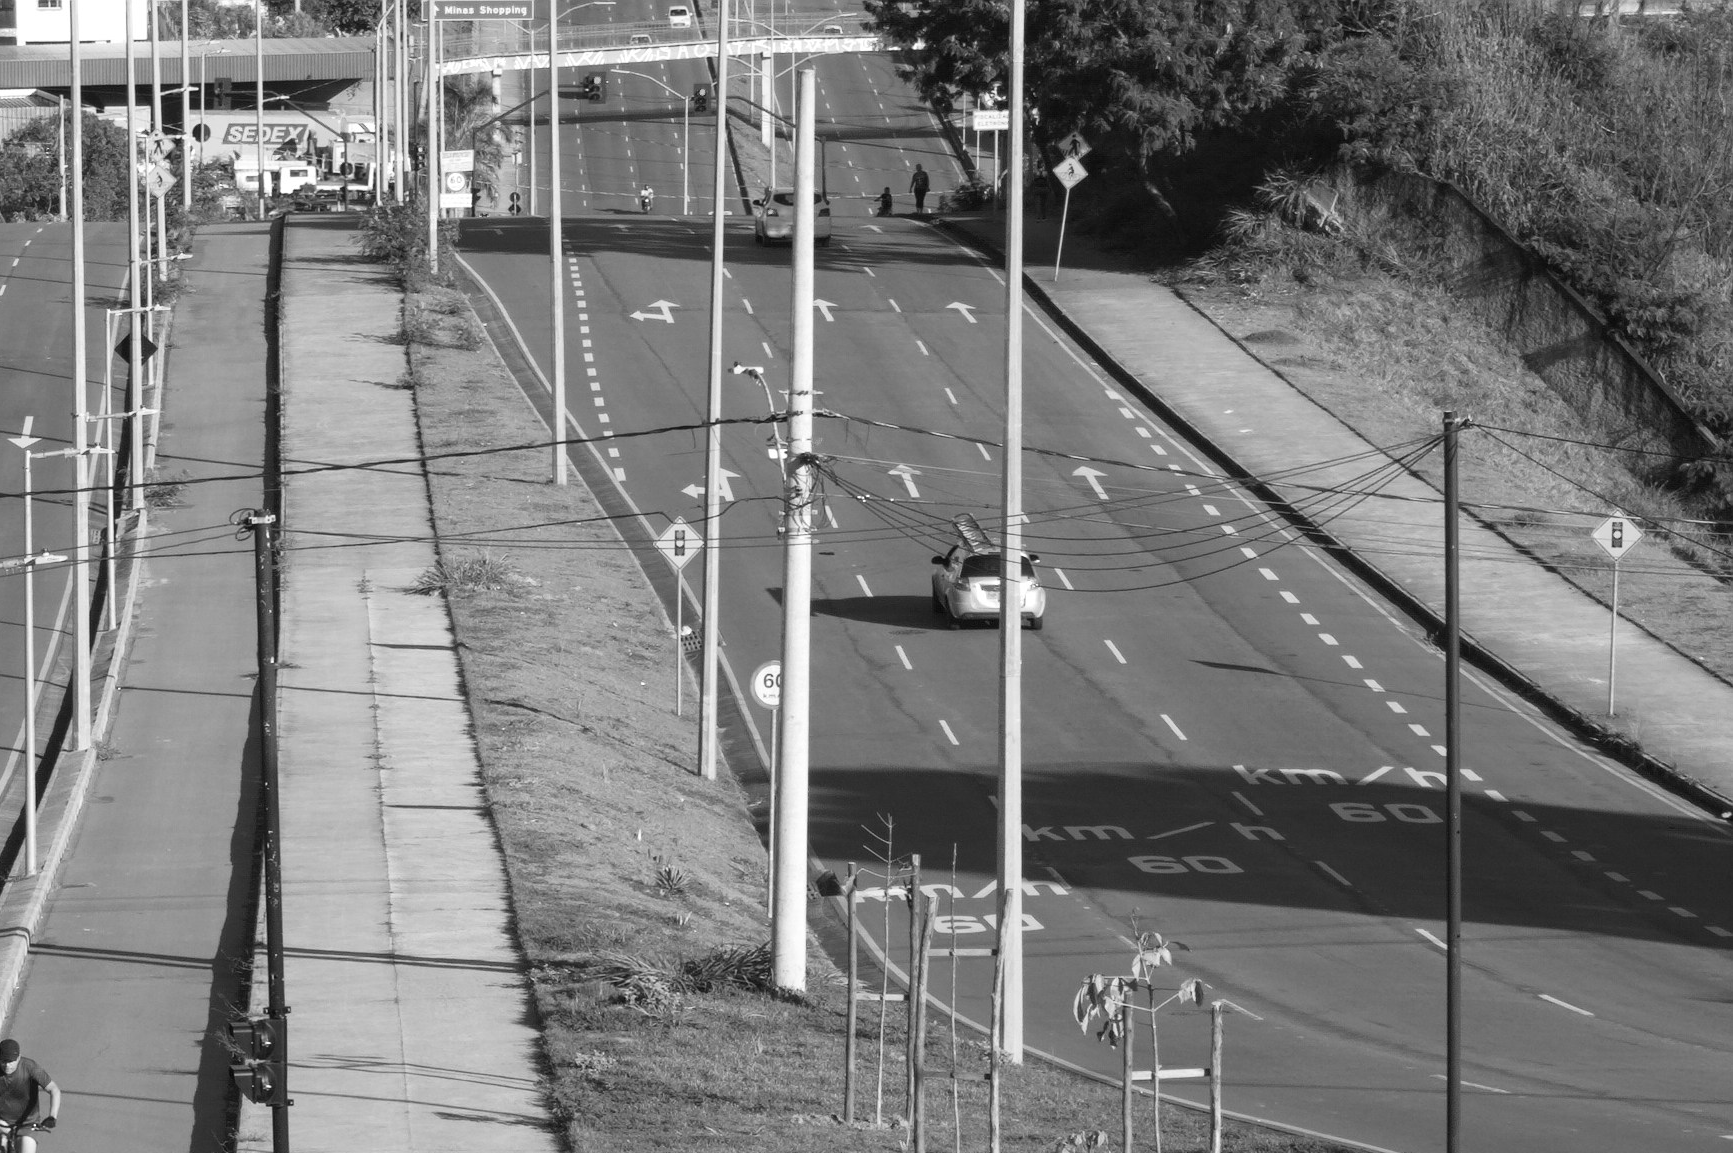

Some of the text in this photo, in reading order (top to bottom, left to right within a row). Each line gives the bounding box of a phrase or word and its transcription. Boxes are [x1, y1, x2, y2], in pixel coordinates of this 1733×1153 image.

[444, 5, 528, 17] Minas Shopping
[227, 125, 304, 143] SEDEX
[449, 175, 463, 184] 60
[1232, 764, 1447, 788] km/h
[1328, 802, 1444, 824] 60
[1126, 855, 1245, 874] 60
[933, 913, 1045, 934] 60
